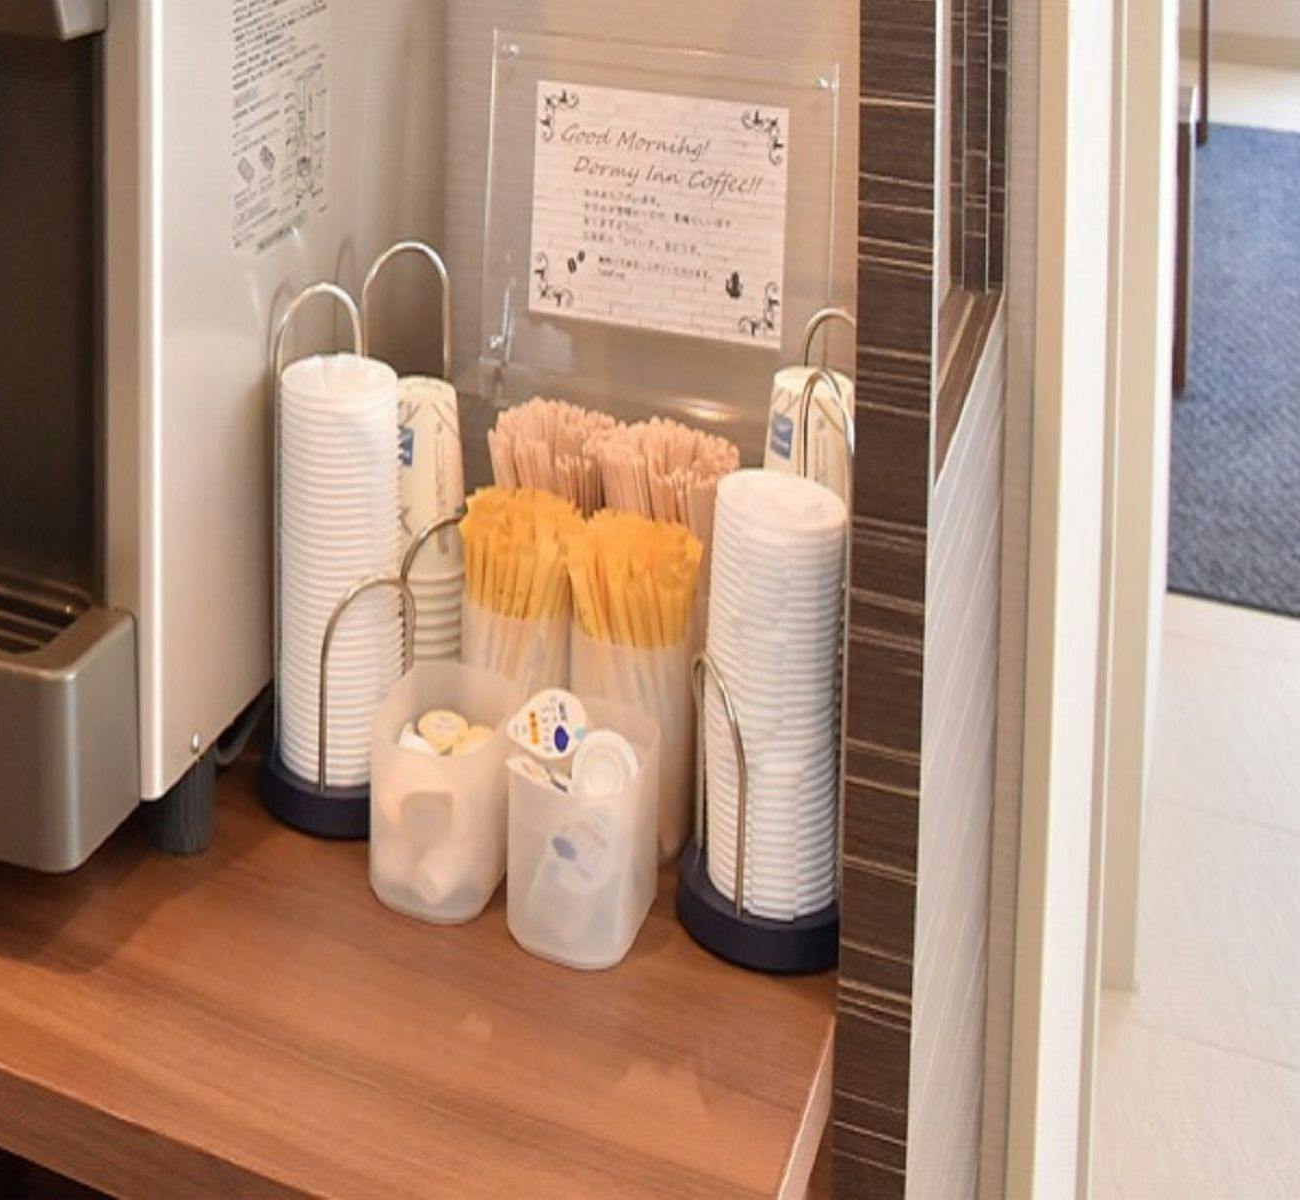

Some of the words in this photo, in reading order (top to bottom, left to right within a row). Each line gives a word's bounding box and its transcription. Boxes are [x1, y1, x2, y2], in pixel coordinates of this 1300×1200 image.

[560, 122, 611, 148] Good
[573, 155, 640, 188] Dormy
[645, 165, 680, 185] Inn
[687, 172, 764, 197] Coffee!!
